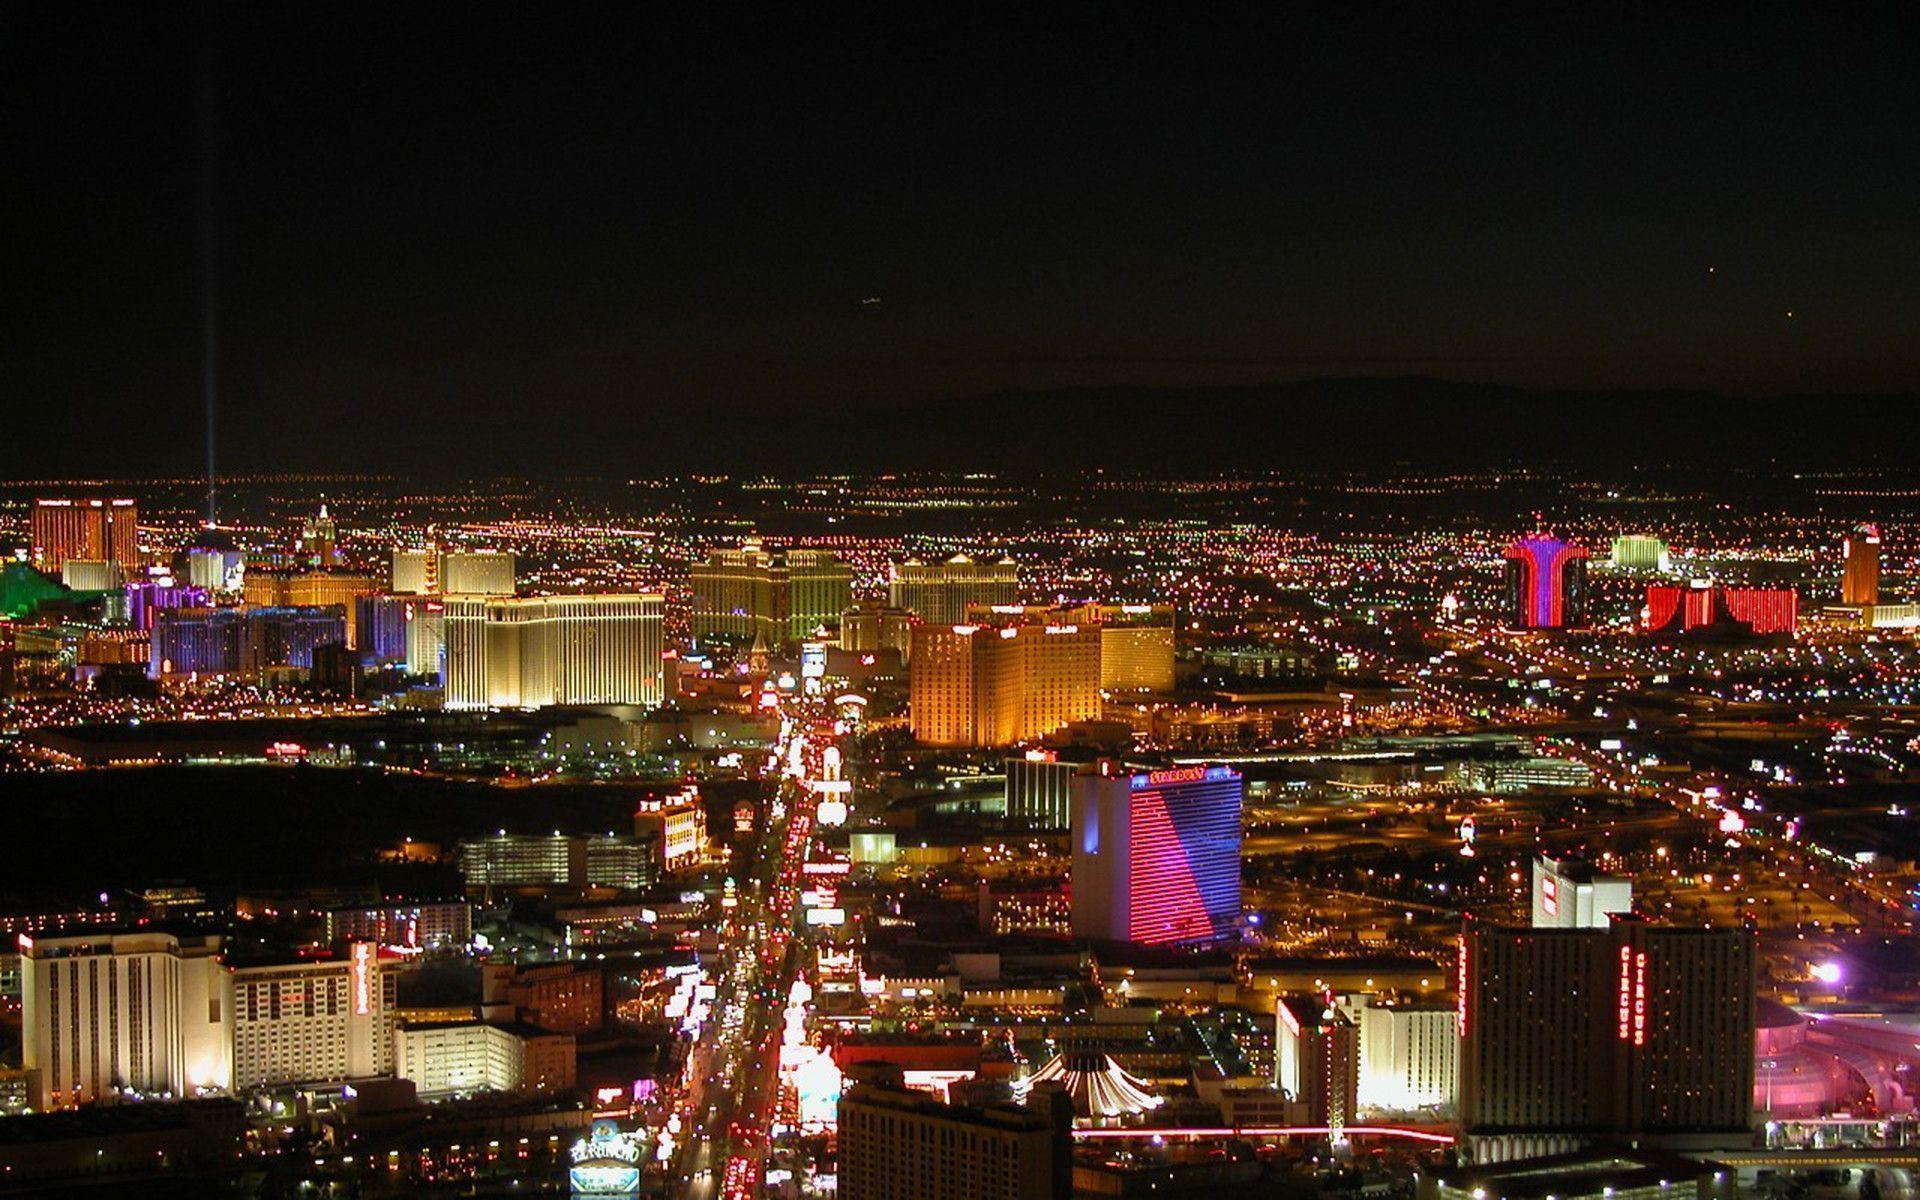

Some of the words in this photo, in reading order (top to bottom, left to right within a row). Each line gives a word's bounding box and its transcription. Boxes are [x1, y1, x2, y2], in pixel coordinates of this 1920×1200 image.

[1150, 768, 1204, 783] STARDUST
[1619, 946, 1629, 1038] CIRCUS
[1635, 953, 1645, 1045] CIRCUS
